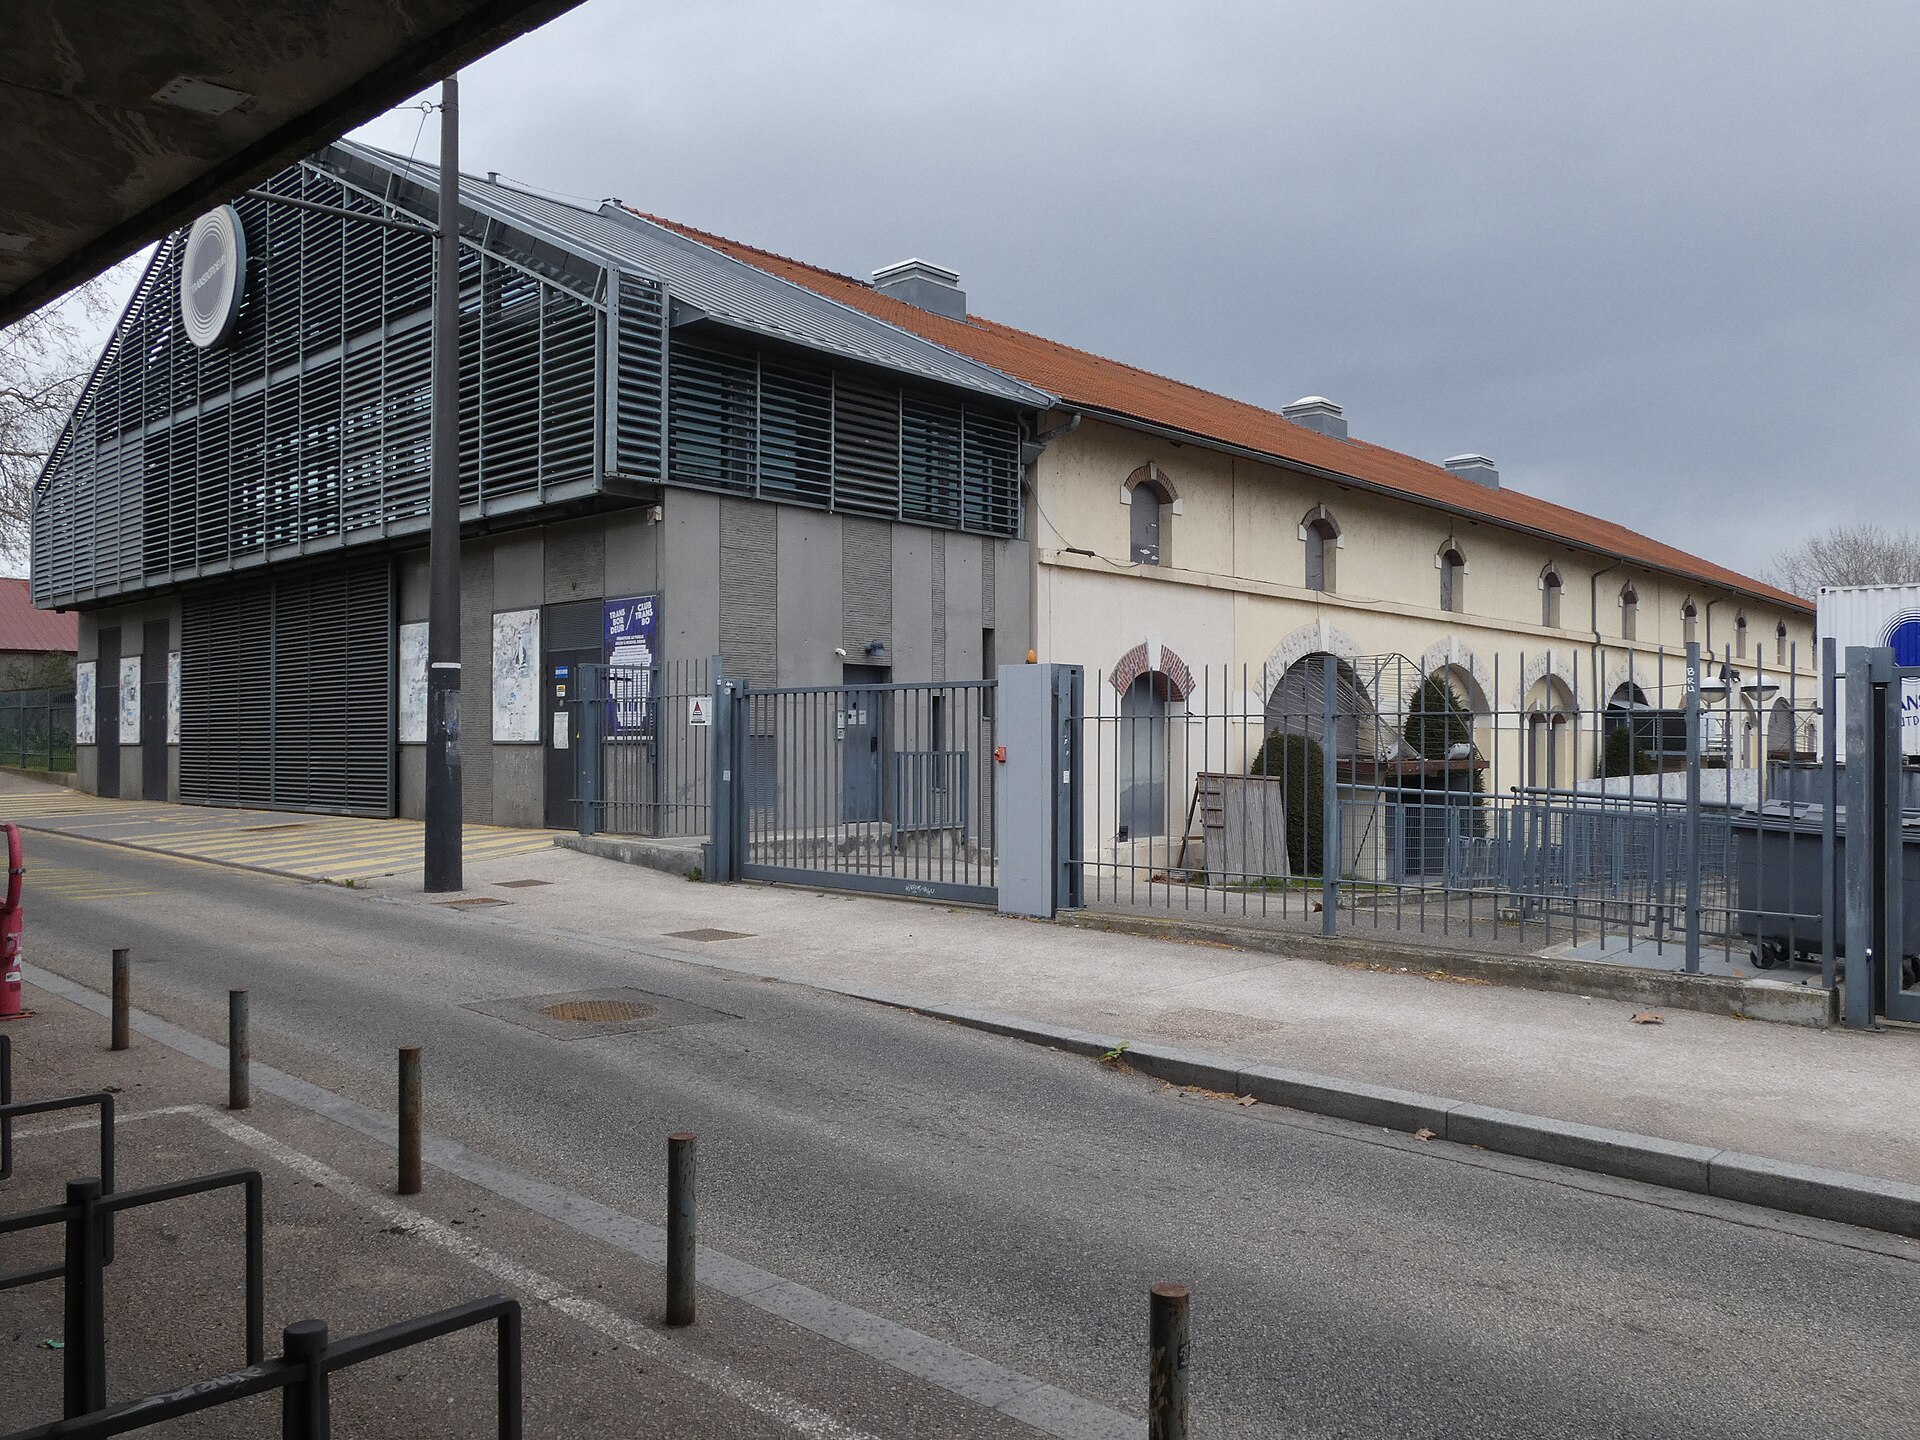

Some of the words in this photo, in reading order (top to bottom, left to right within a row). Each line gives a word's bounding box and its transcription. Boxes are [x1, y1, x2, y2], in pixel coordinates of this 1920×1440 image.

[637, 601, 652, 611] CLUB
[609, 608, 625, 619] TRANS
[635, 608, 653, 619] TRANS
[612, 617, 624, 626] BOR
[641, 617, 650, 625] BO
[610, 624, 625, 634] DEUR
